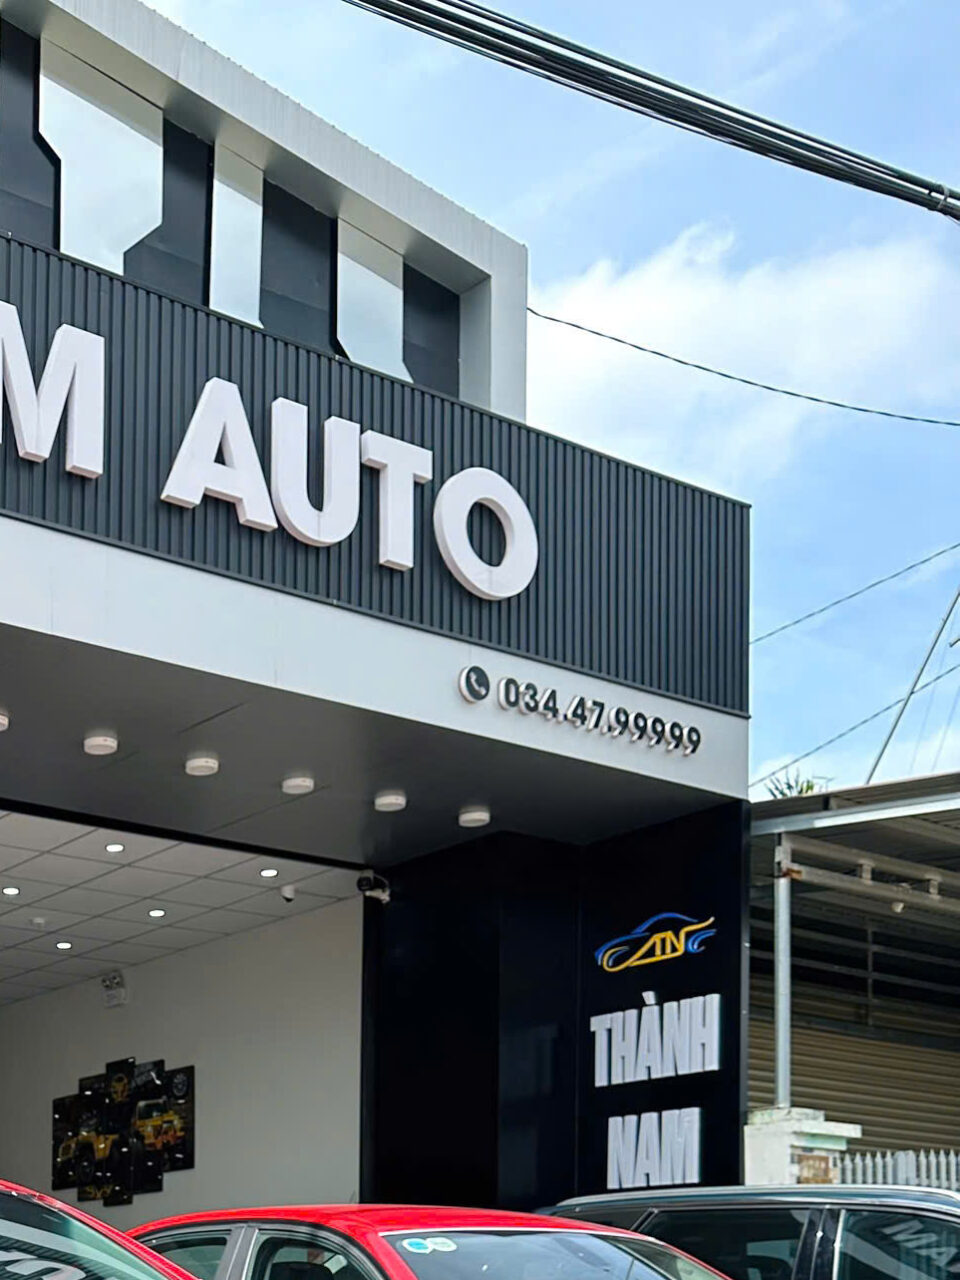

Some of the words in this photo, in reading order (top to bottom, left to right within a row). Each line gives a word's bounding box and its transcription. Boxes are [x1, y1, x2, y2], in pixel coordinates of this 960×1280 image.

[161, 377, 539, 601] AUTO
[498, 677, 701, 756] 034.47.99999
[590, 991, 721, 1087] THÀNH
[607, 1107, 700, 1190] NAM
